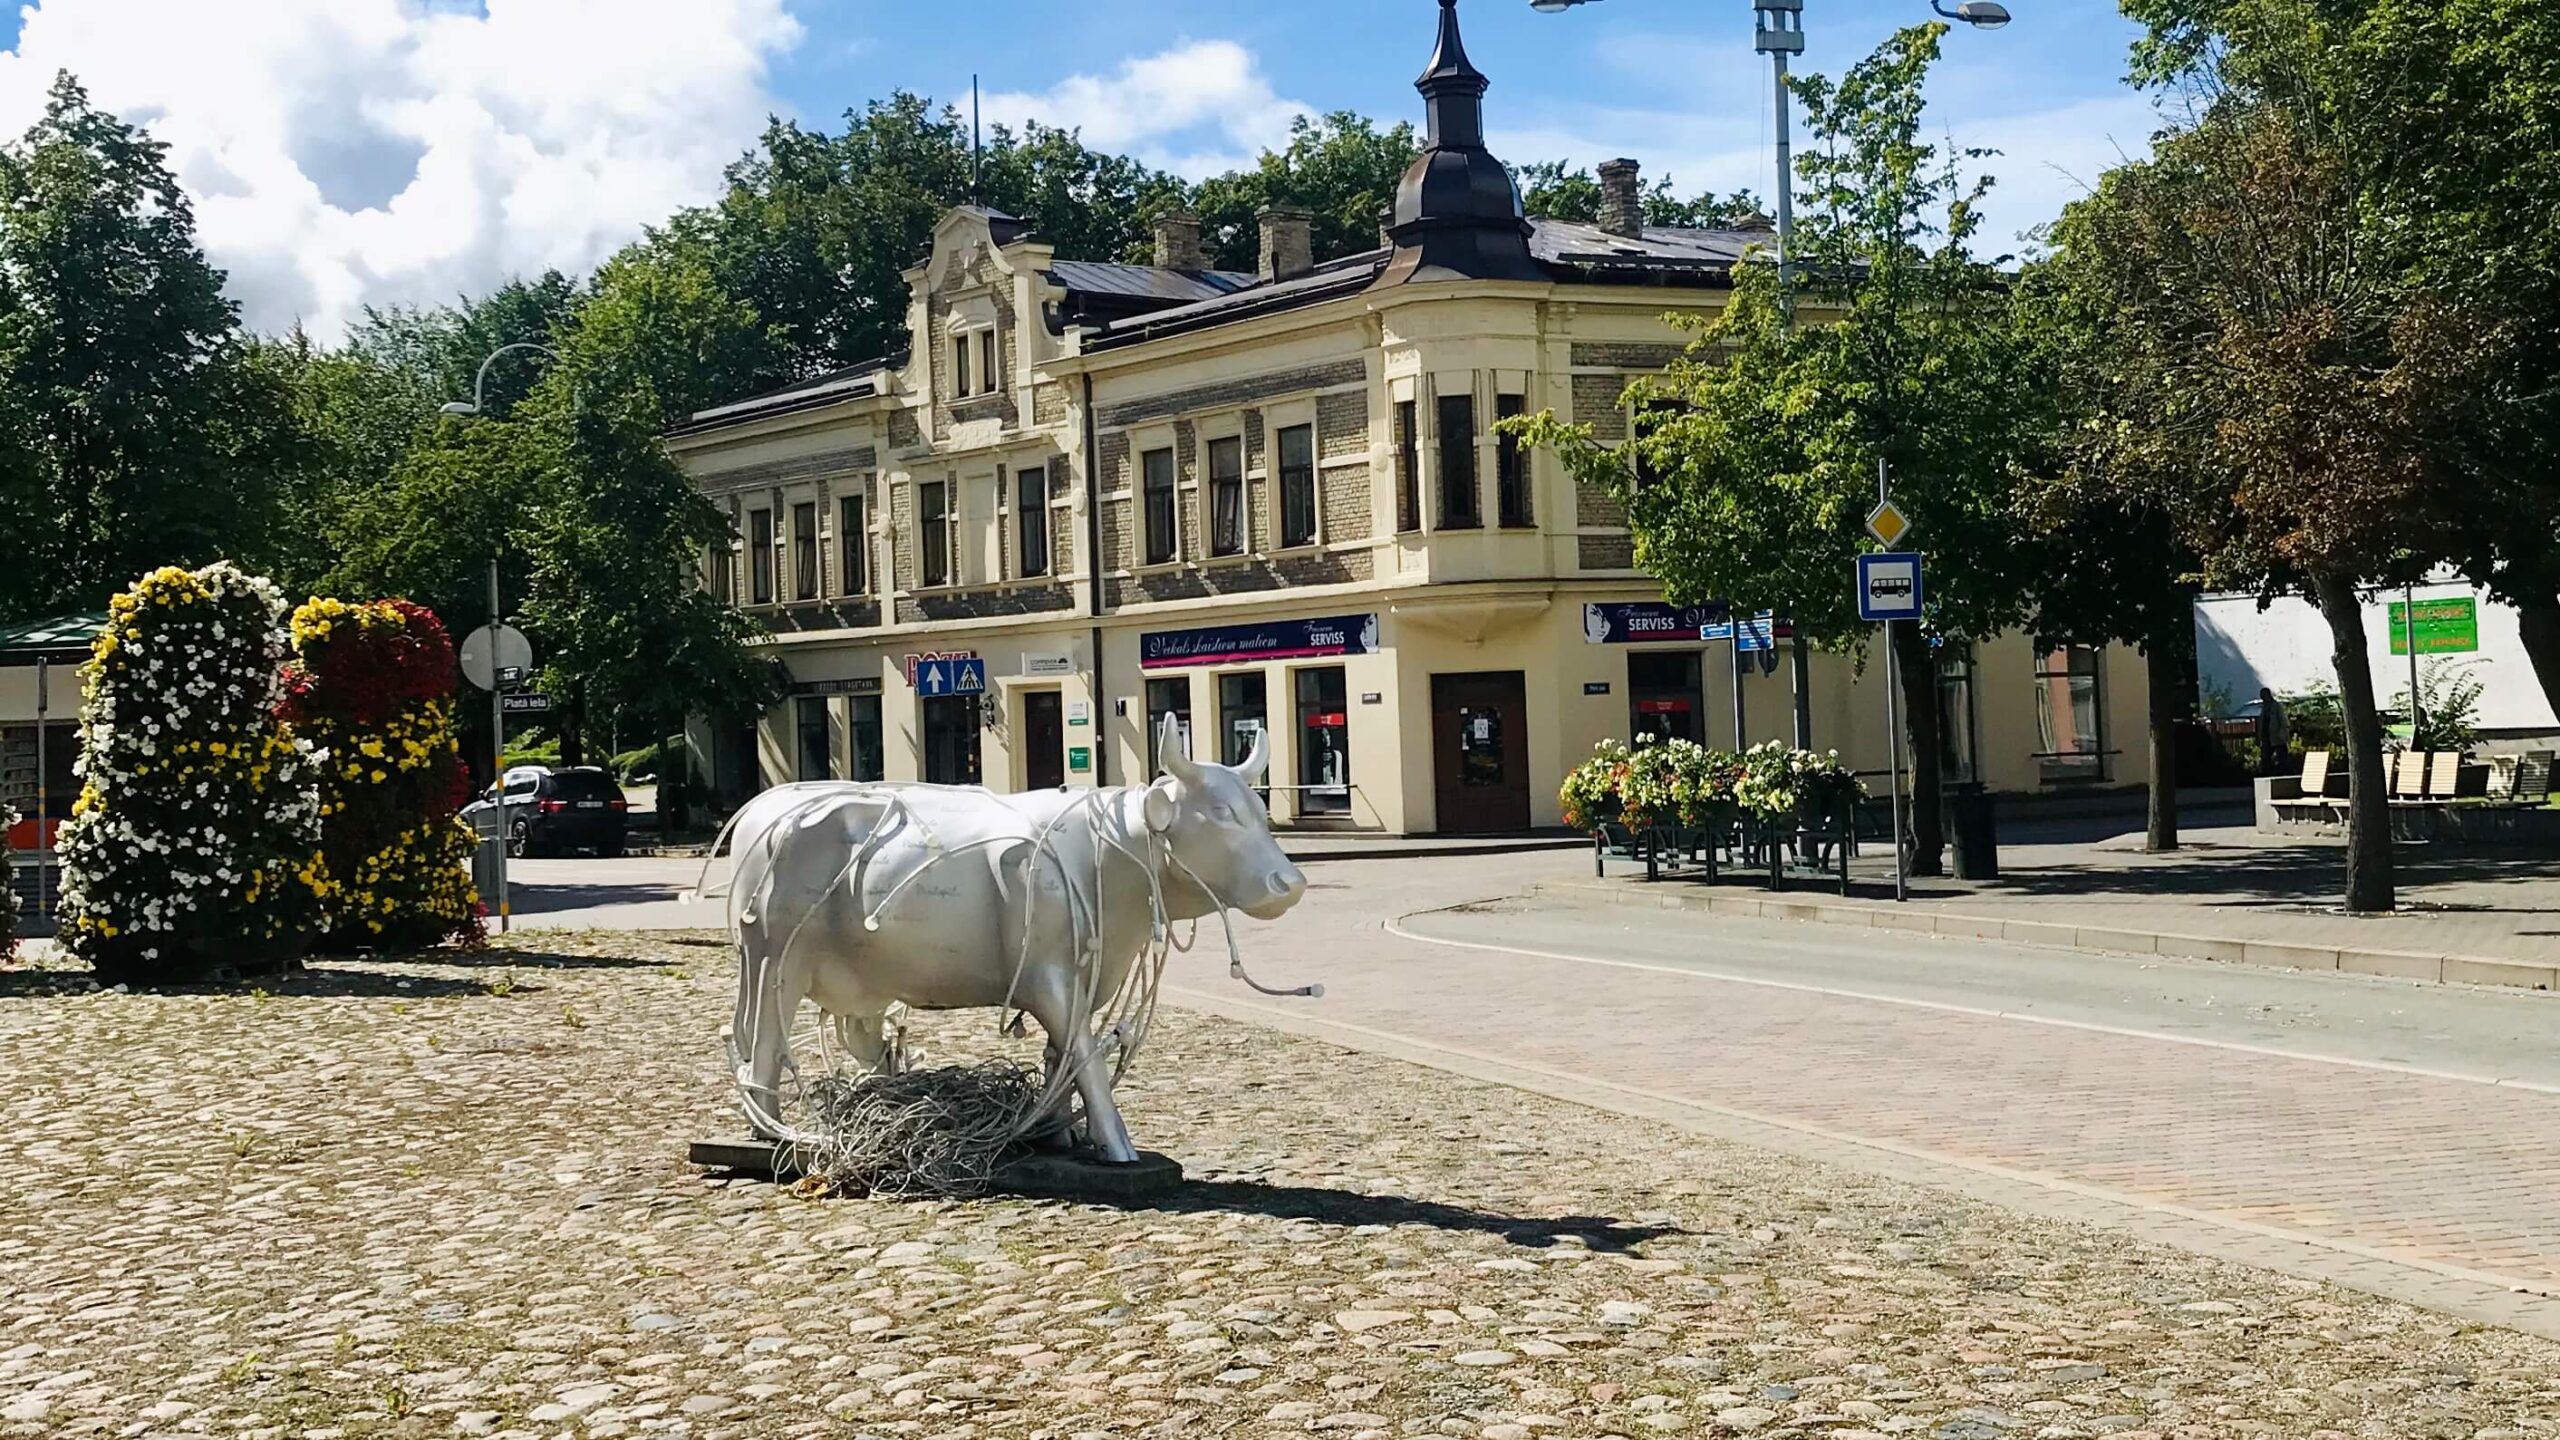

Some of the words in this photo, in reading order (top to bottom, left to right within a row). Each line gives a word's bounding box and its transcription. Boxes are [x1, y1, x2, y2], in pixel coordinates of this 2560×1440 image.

[1628, 617, 1675, 631] SERVISS
[1150, 635, 1190, 657] Veikals
[1310, 631, 1345, 646] SERVISS
